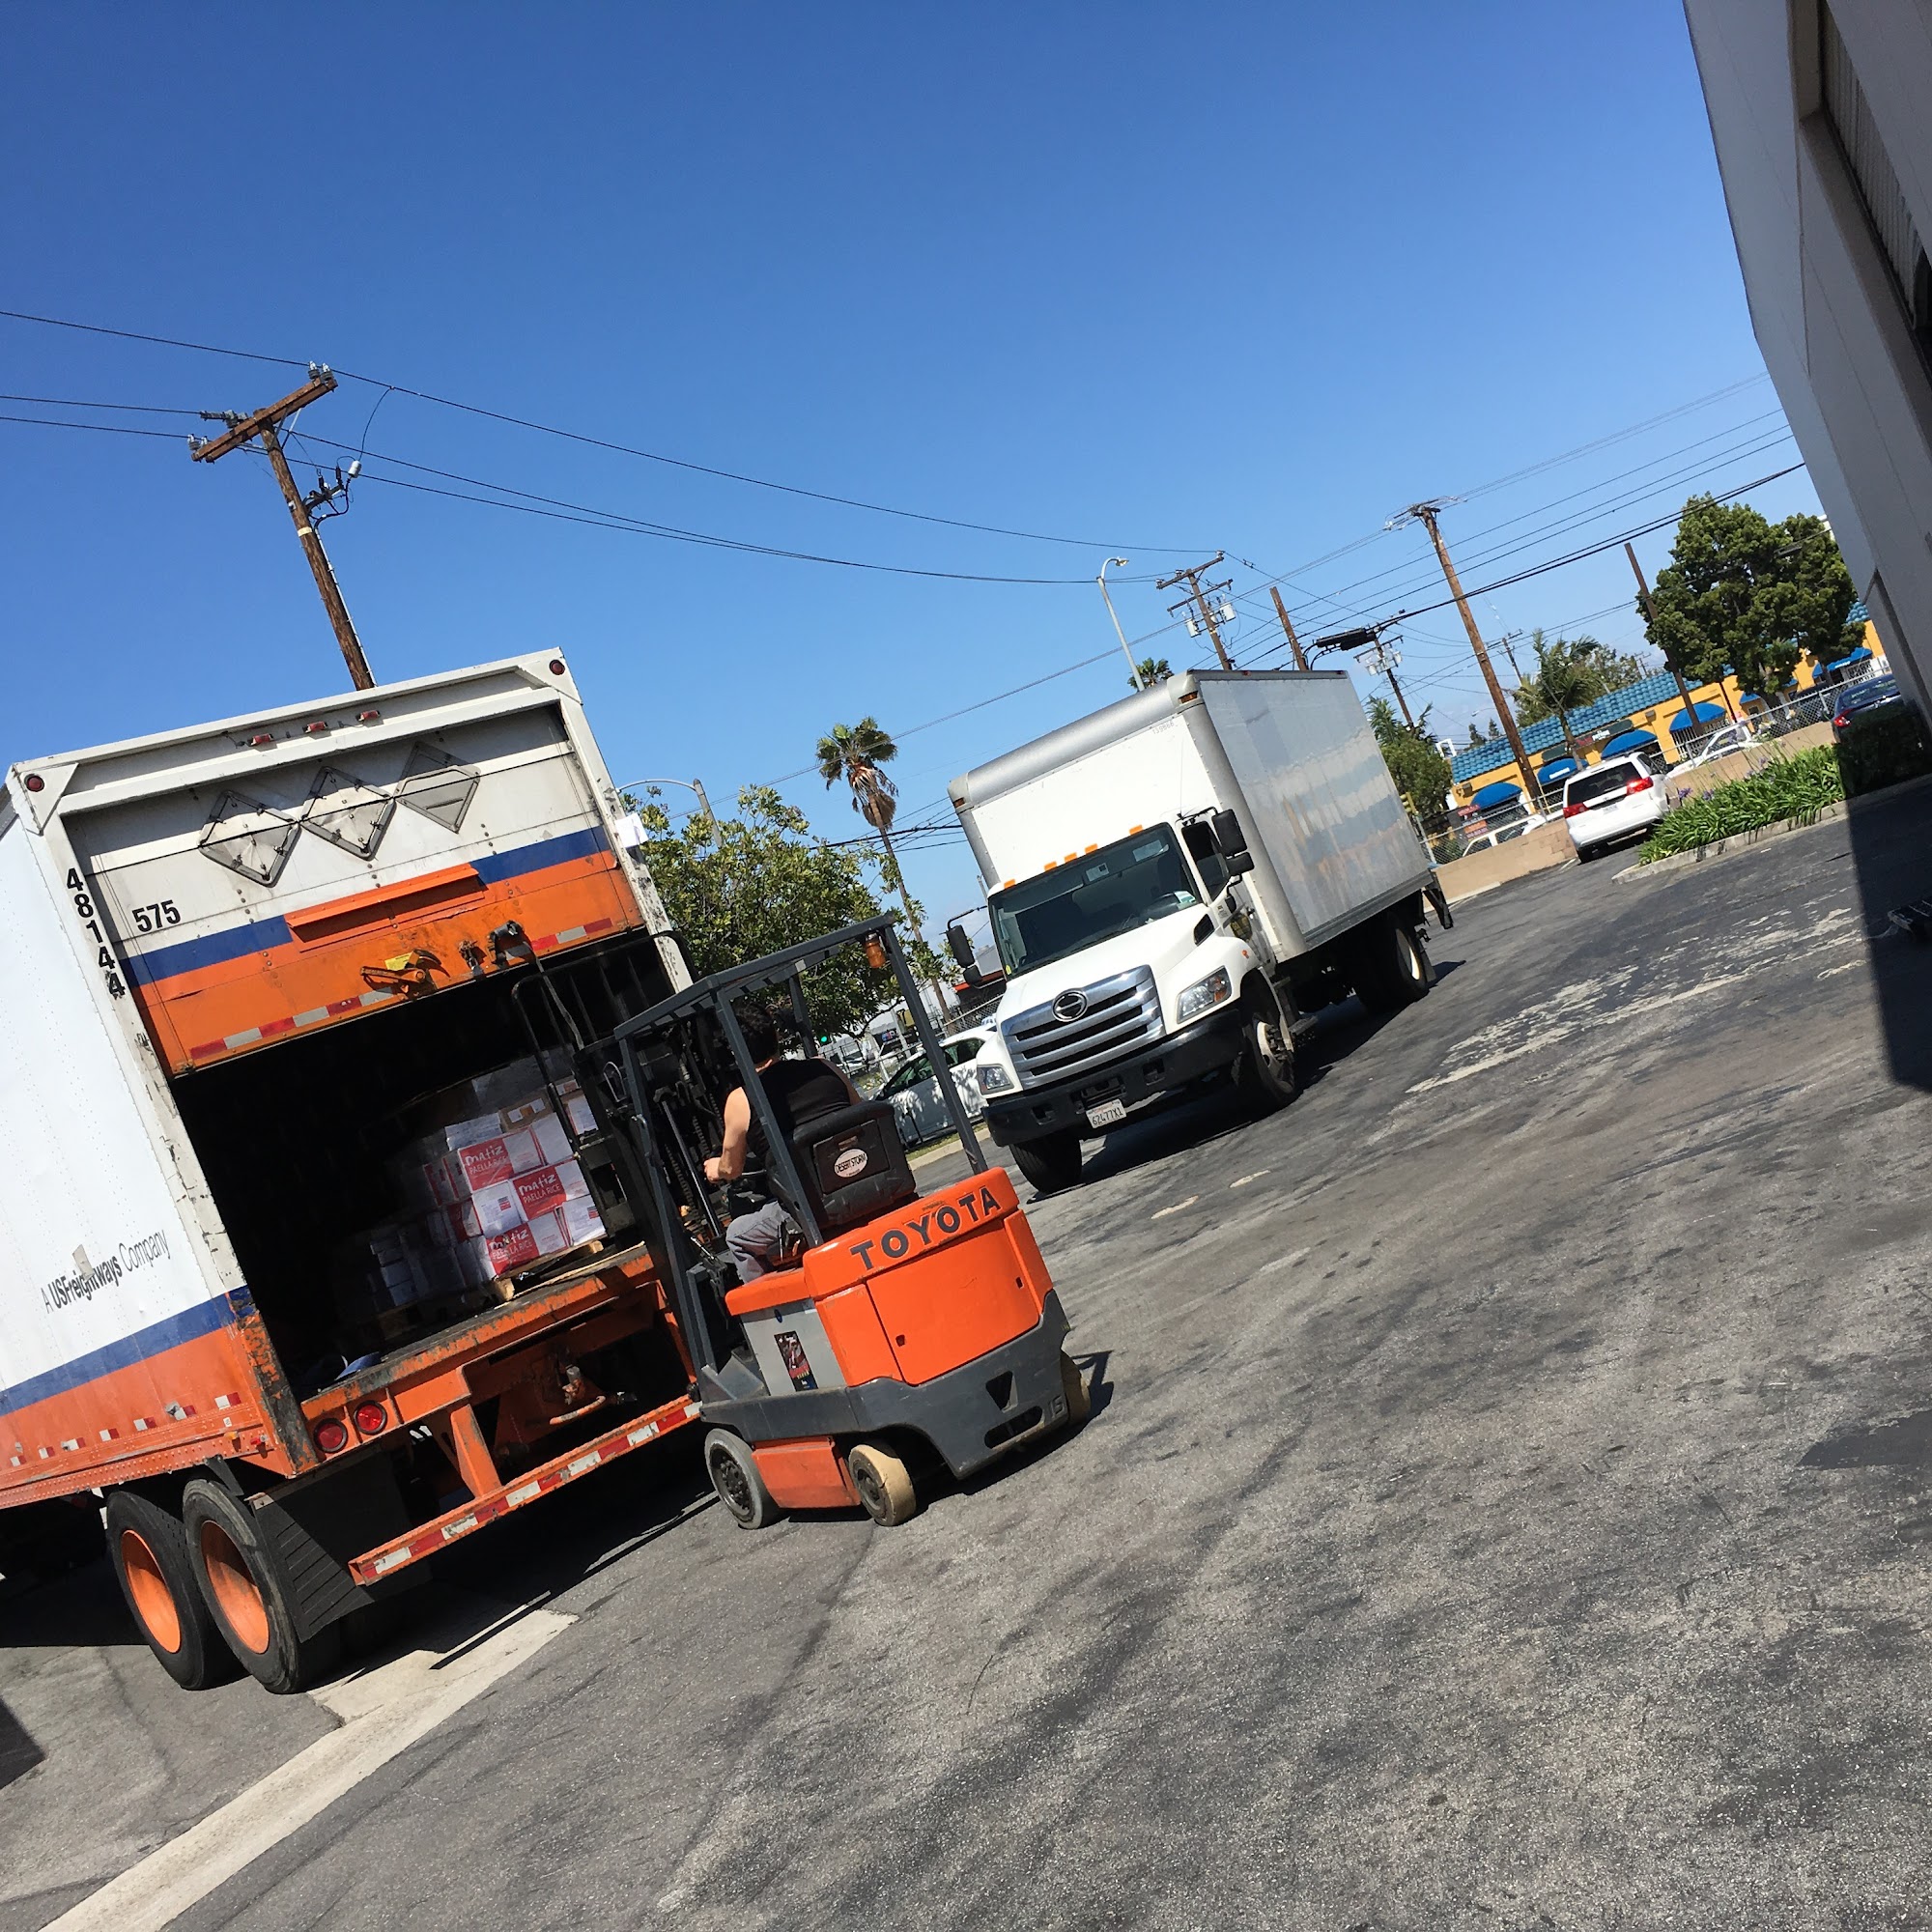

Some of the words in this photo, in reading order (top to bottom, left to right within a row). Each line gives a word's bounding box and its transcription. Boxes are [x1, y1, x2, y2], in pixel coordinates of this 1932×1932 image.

[66, 867, 126, 997] 48144
[131, 899, 182, 932] 575
[465, 1145, 504, 1167] matiz
[519, 1174, 557, 1197] matiz
[523, 1189, 547, 1204] PAELLA
[546, 1183, 560, 1195] RICE
[849, 1185, 1002, 1271] TOYOTA
[41, 1287, 55, 1314] A
[118, 1229, 171, 1272] Company
